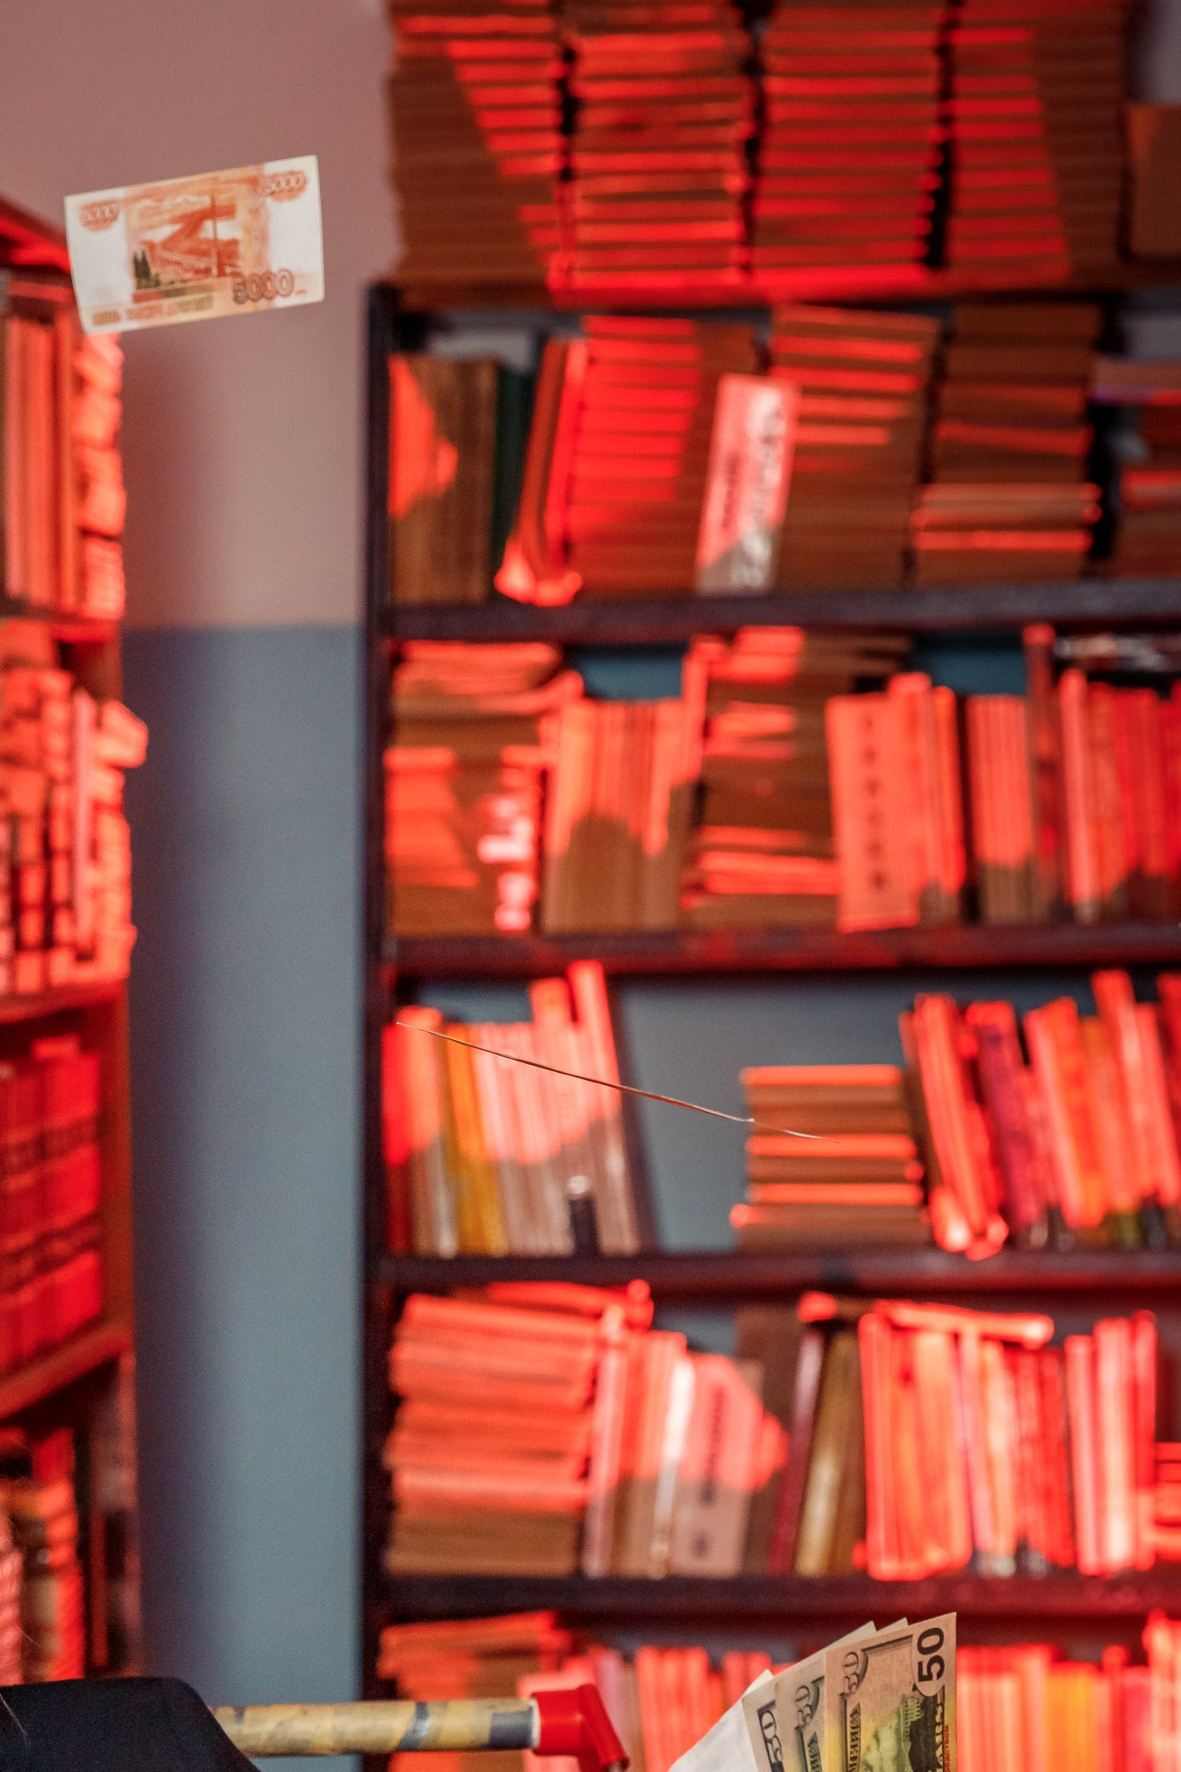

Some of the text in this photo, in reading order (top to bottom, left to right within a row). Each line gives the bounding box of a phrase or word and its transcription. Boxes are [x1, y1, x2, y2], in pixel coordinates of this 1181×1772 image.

[232, 268, 295, 304] 5000
[841, 1651, 861, 1693] 50
[914, 1625, 948, 1683] 50
[760, 1711, 782, 1764] 50
